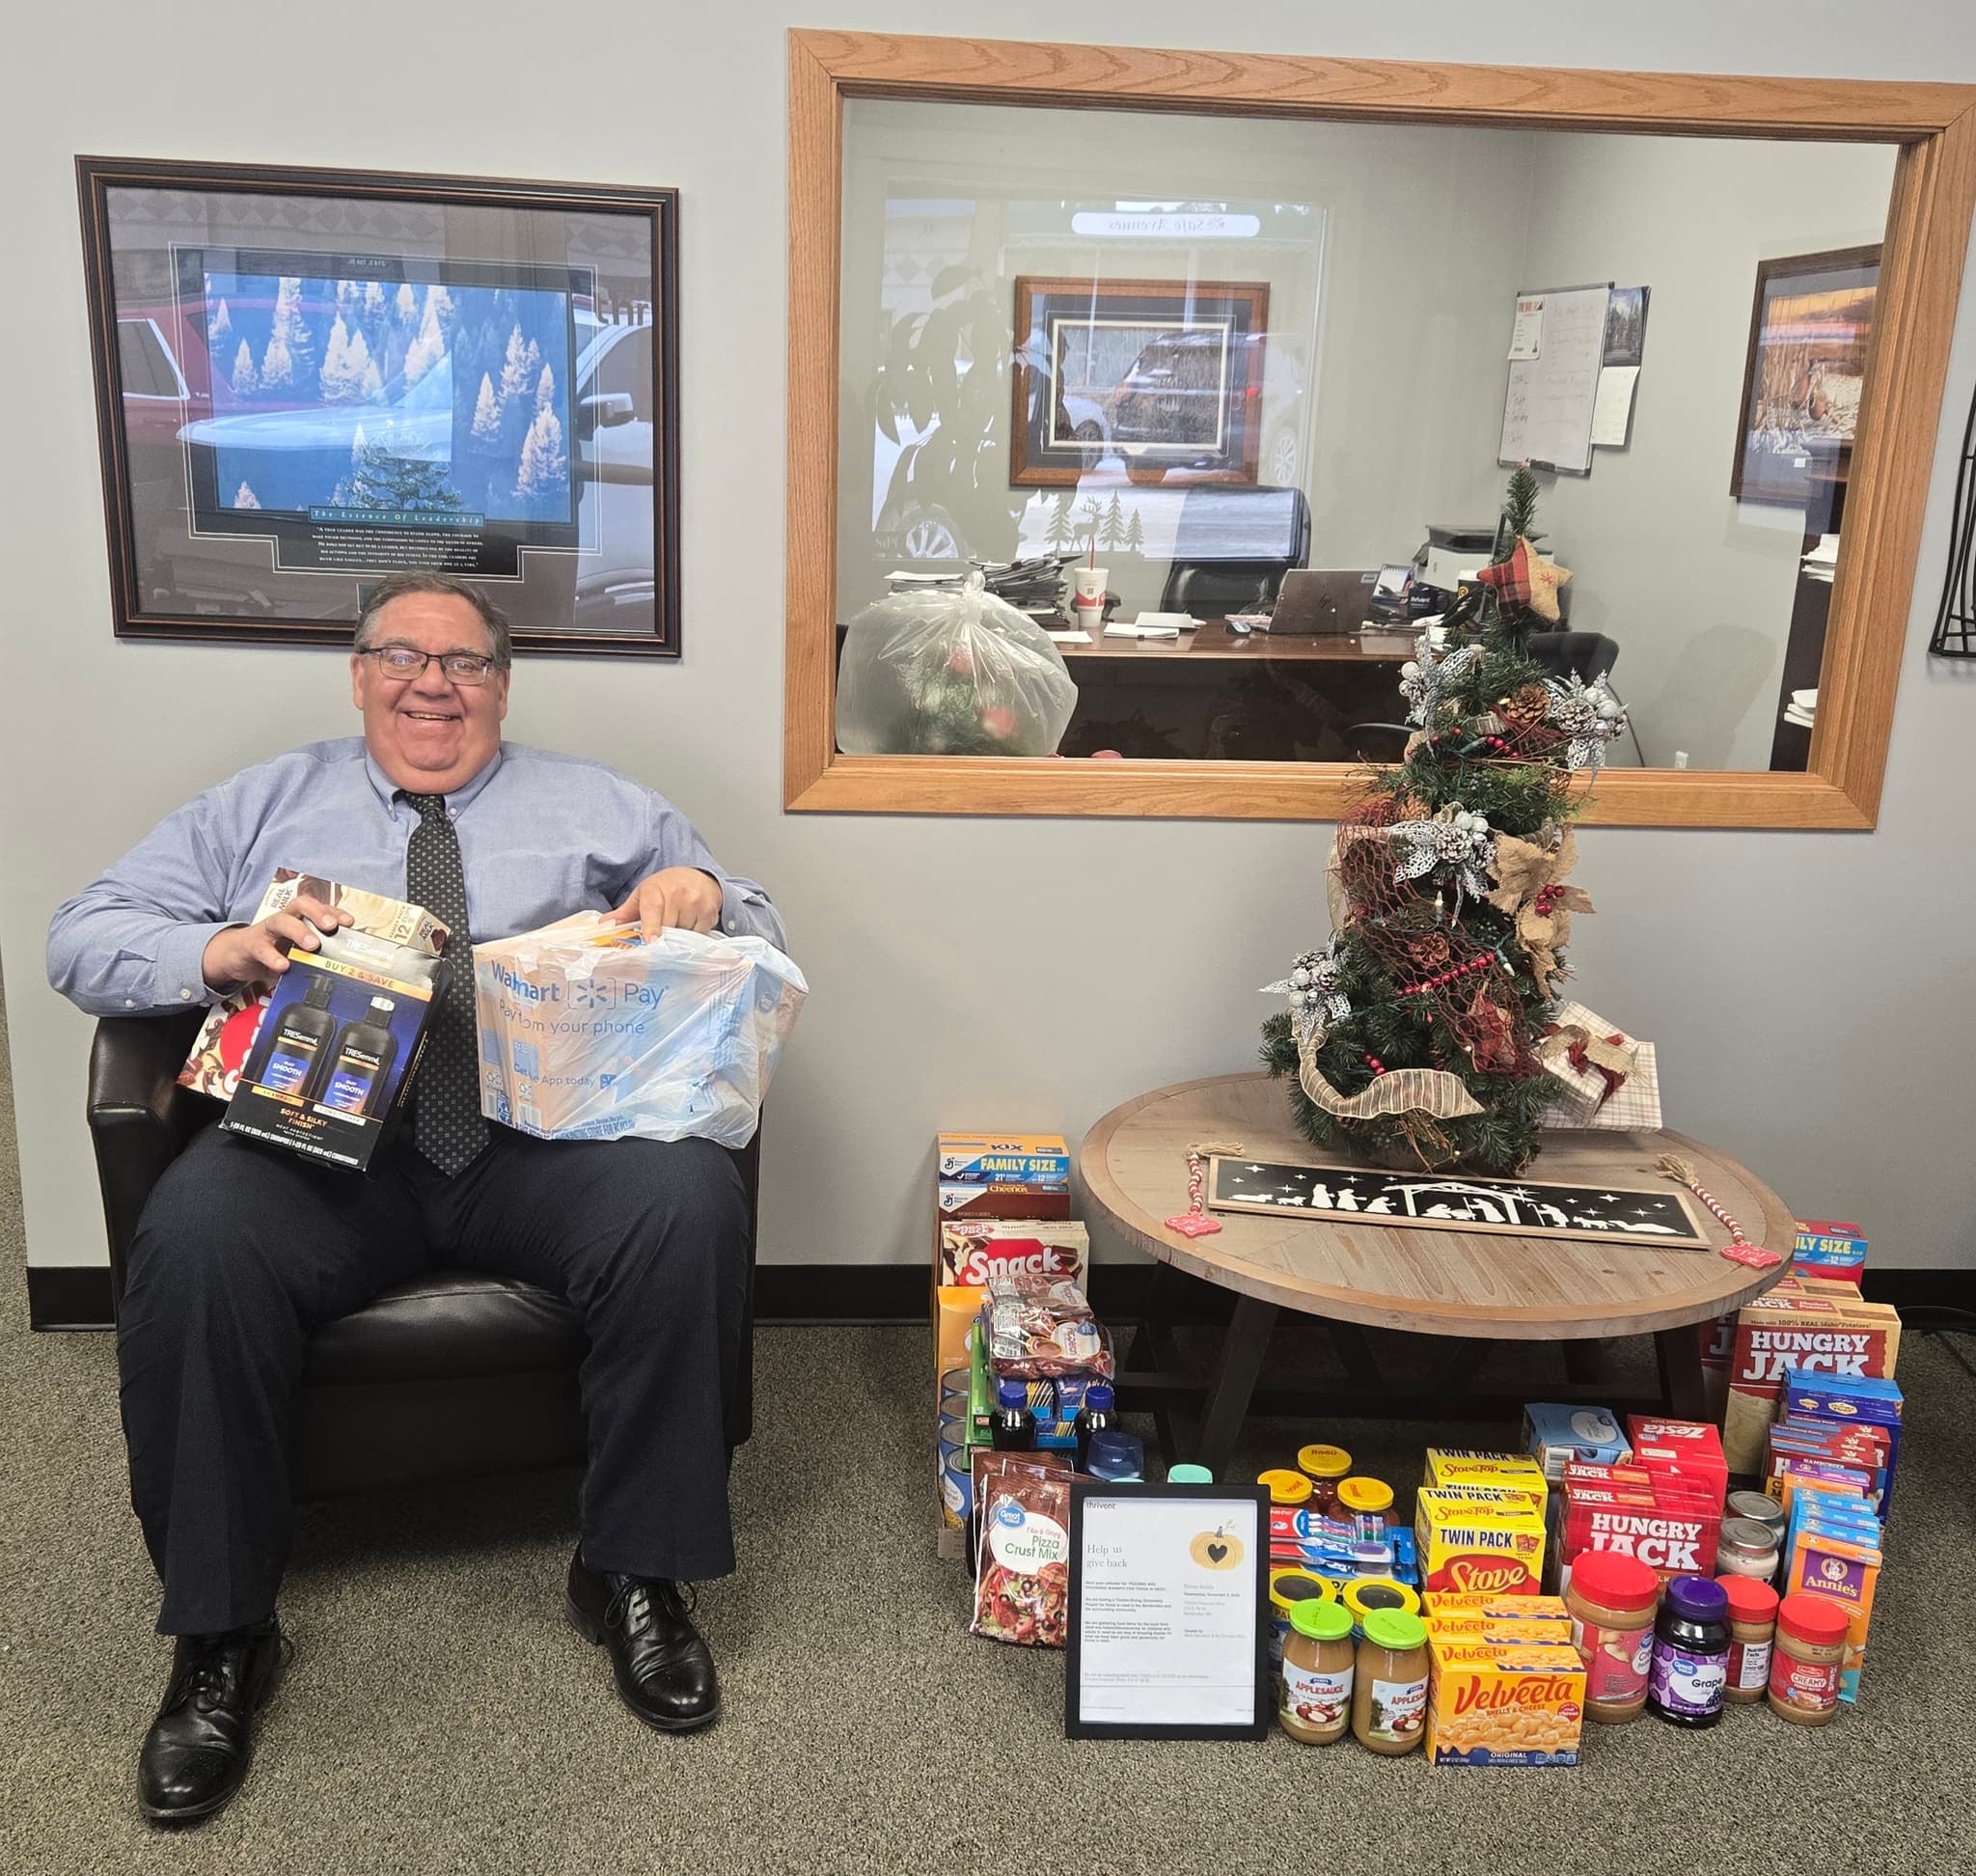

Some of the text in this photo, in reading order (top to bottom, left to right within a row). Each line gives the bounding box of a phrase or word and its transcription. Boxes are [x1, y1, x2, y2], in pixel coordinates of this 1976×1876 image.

[314, 510, 480, 525] The Essence Of Leadership
[271, 887, 287, 908] REAL
[394, 924, 411, 940] 12
[324, 960, 347, 973] BUY
[357, 970, 365, 979] &
[367, 973, 396, 989] SAVE
[624, 982, 665, 1010] Pay
[550, 1020, 589, 1035] your
[593, 1019, 645, 1036] phone
[272, 1062, 302, 1077] SMOOTH
[334, 1081, 365, 1096] SMOOTH
[541, 1074, 596, 1089] App today
[280, 1108, 300, 1118] SOFT
[307, 1115, 329, 1128] SILKY
[980, 1157, 1027, 1172] FAMILY
[1029, 1158, 1057, 1172] SIZE
[1819, 1239, 1852, 1255] SIZE
[966, 1246, 1062, 1285] Snack
[1751, 1331, 1871, 1353] HUNGRY
[1743, 1351, 1870, 1382] JACK
[1642, 1423, 1707, 1439] Zesta
[1434, 1448, 1511, 1462] TWIN PACK
[1568, 1468, 1613, 1479] JACK
[1426, 1489, 1504, 1503] TWIN PACK
[1572, 1492, 1616, 1503] JACK
[1086, 1501, 1117, 1510] thrivent
[1591, 1512, 1703, 1541] HUNGRY
[1031, 1535, 1059, 1550] Pizza
[1440, 1529, 1513, 1548] TWIN PACK
[1004, 1542, 1059, 1560] Crust Mix
[1087, 1544, 1110, 1556] Help
[1086, 1559, 1128, 1569] give back
[1450, 1561, 1528, 1593] Stove
[1805, 1575, 1859, 1597] Annie's
[1431, 1593, 1495, 1608] Velveeta
[1431, 1618, 1496, 1633] Velveeta
[1441, 1645, 1508, 1662] Velveeta
[1295, 1680, 1344, 1696] APPLESAUCE
[1691, 1677, 1722, 1690] Grape
[1793, 1674, 1825, 1687] CREAMY
[1454, 1674, 1575, 1715] Velveeta
